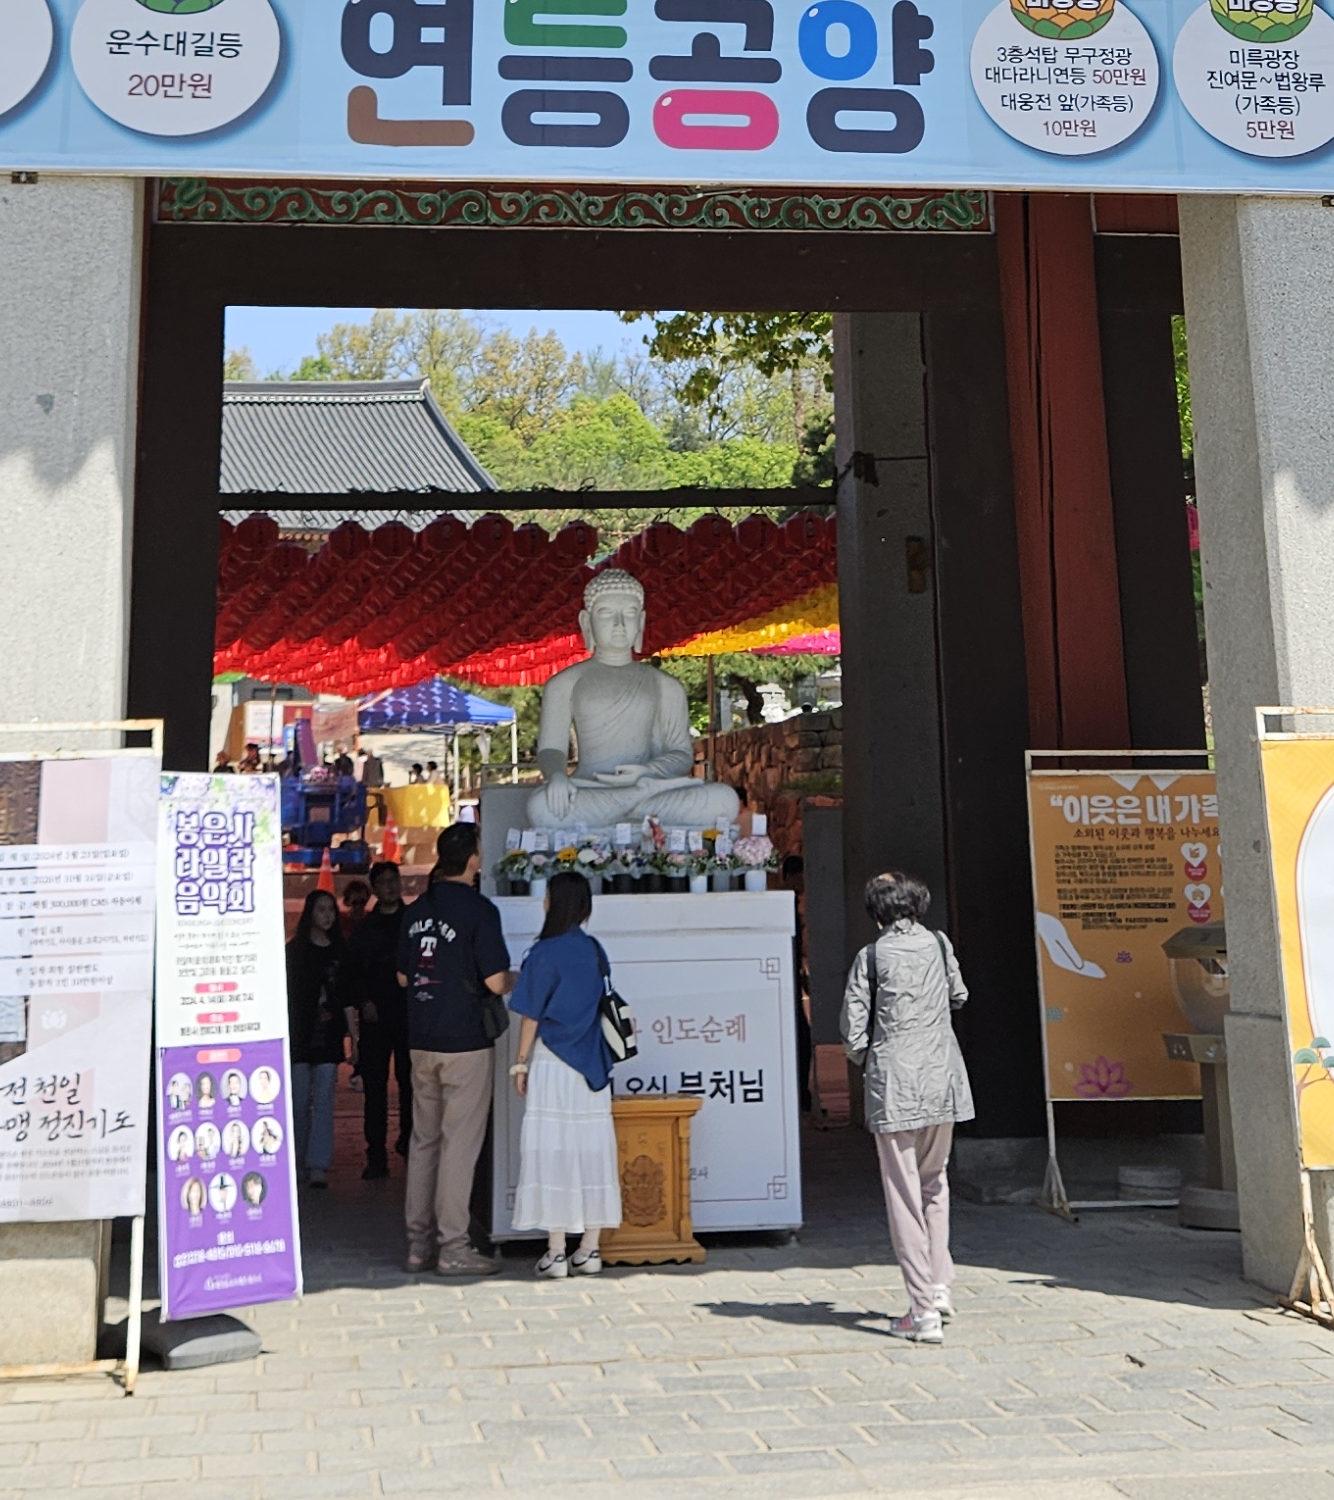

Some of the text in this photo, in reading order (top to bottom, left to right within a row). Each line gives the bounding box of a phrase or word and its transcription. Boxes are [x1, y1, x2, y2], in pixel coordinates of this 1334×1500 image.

[106, 29, 243, 59] 운수대길등
[997, 47, 1132, 65] 3층석탑 무구정광
[1230, 49, 1299, 70] 미륵광장
[128, 72, 213, 100] 20만원
[985, 67, 1146, 86] 대다라니연등 50만원
[1001, 93, 1133, 112] 대웅전 앞(가족등)
[1235, 94, 1300, 116] (가족등)
[1043, 120, 1096, 137] 10만원
[1247, 120, 1295, 140] 5만원
[1146, 795, 1171, 824] 내
[176, 811, 256, 846] 봉은사
[1073, 828, 1104, 841] 소외된
[1109, 827, 1140, 840] 이웃과
[1145, 827, 1176, 841] 행복을
[175, 846, 256, 880] 라일락
[176, 879, 255, 915] 음악회
[652, 1014, 745, 1044] 인도순례
[678, 1069, 764, 1104] 부처님
[39, 1108, 135, 1141] 정진기도
